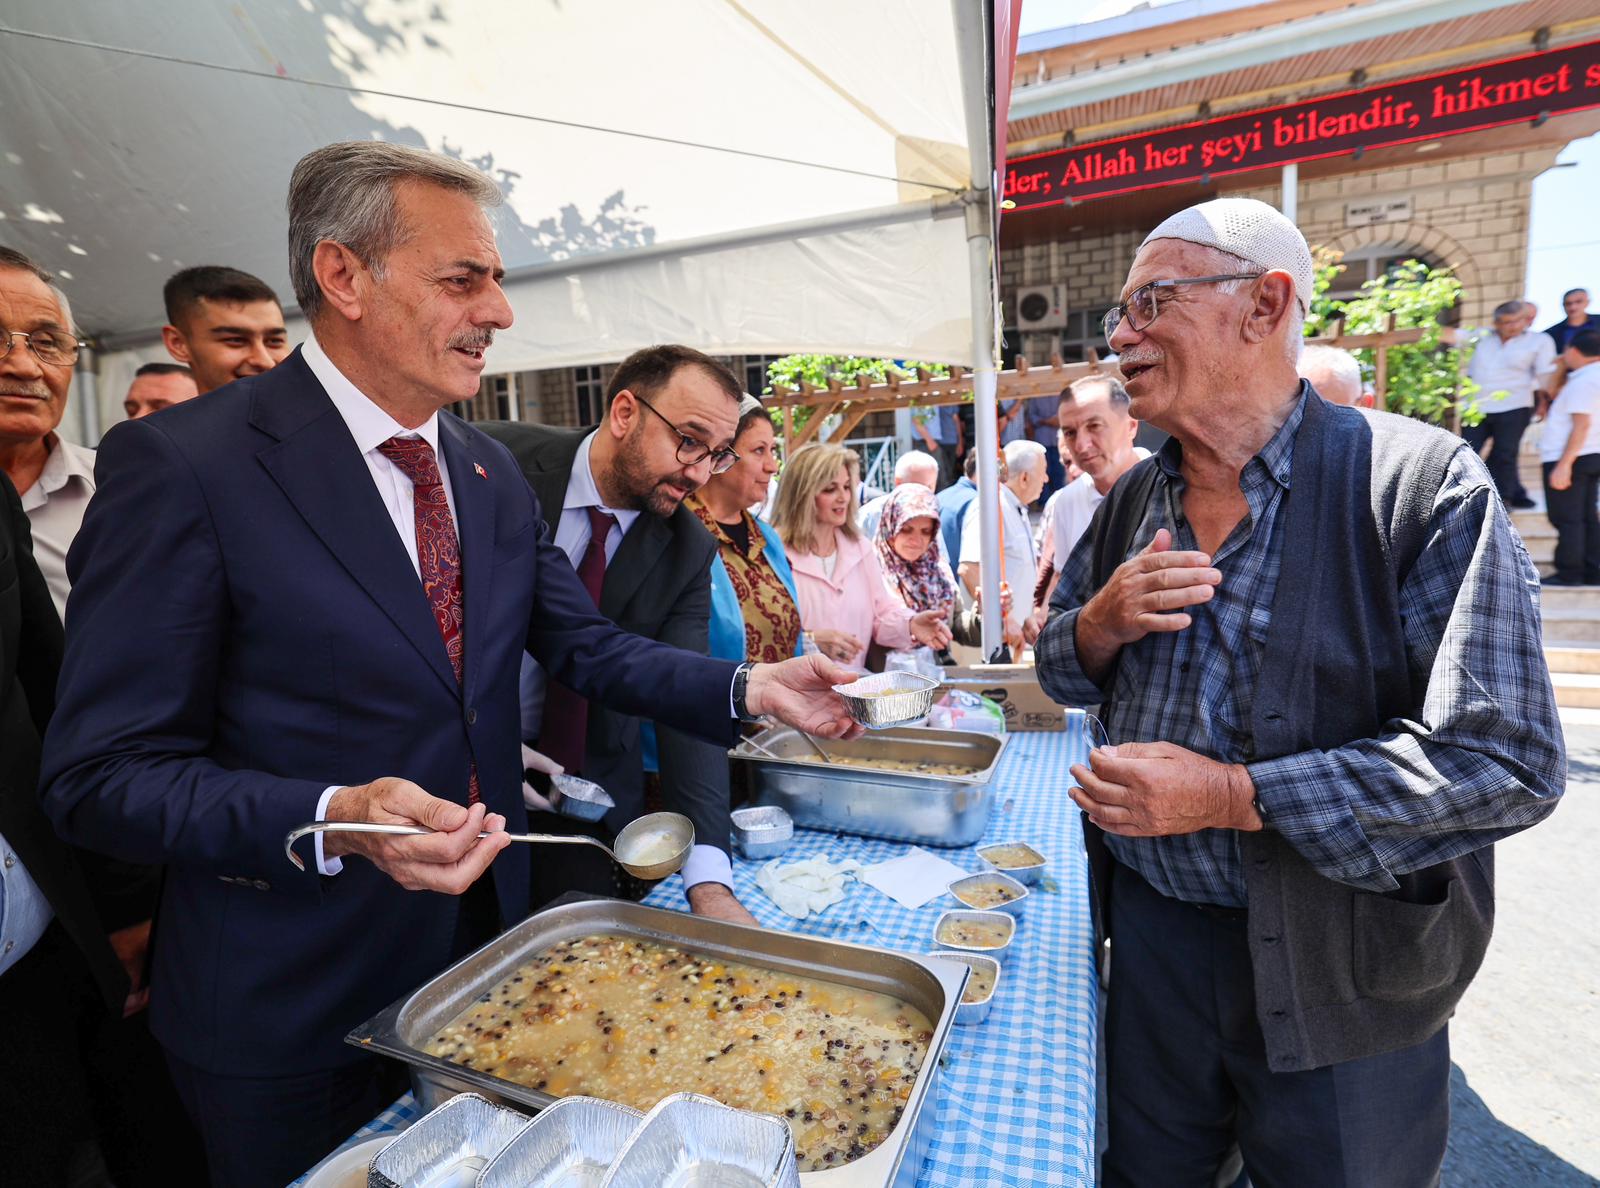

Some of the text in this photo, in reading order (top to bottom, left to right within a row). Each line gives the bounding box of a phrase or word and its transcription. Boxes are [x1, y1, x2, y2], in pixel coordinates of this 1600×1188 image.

[1060, 148, 1137, 187] Allah
[1144, 143, 1194, 171] her
[1201, 121, 1263, 168] şeyi
[1273, 95, 1421, 147] bilendir,
[1431, 64, 1572, 118] hikmet
